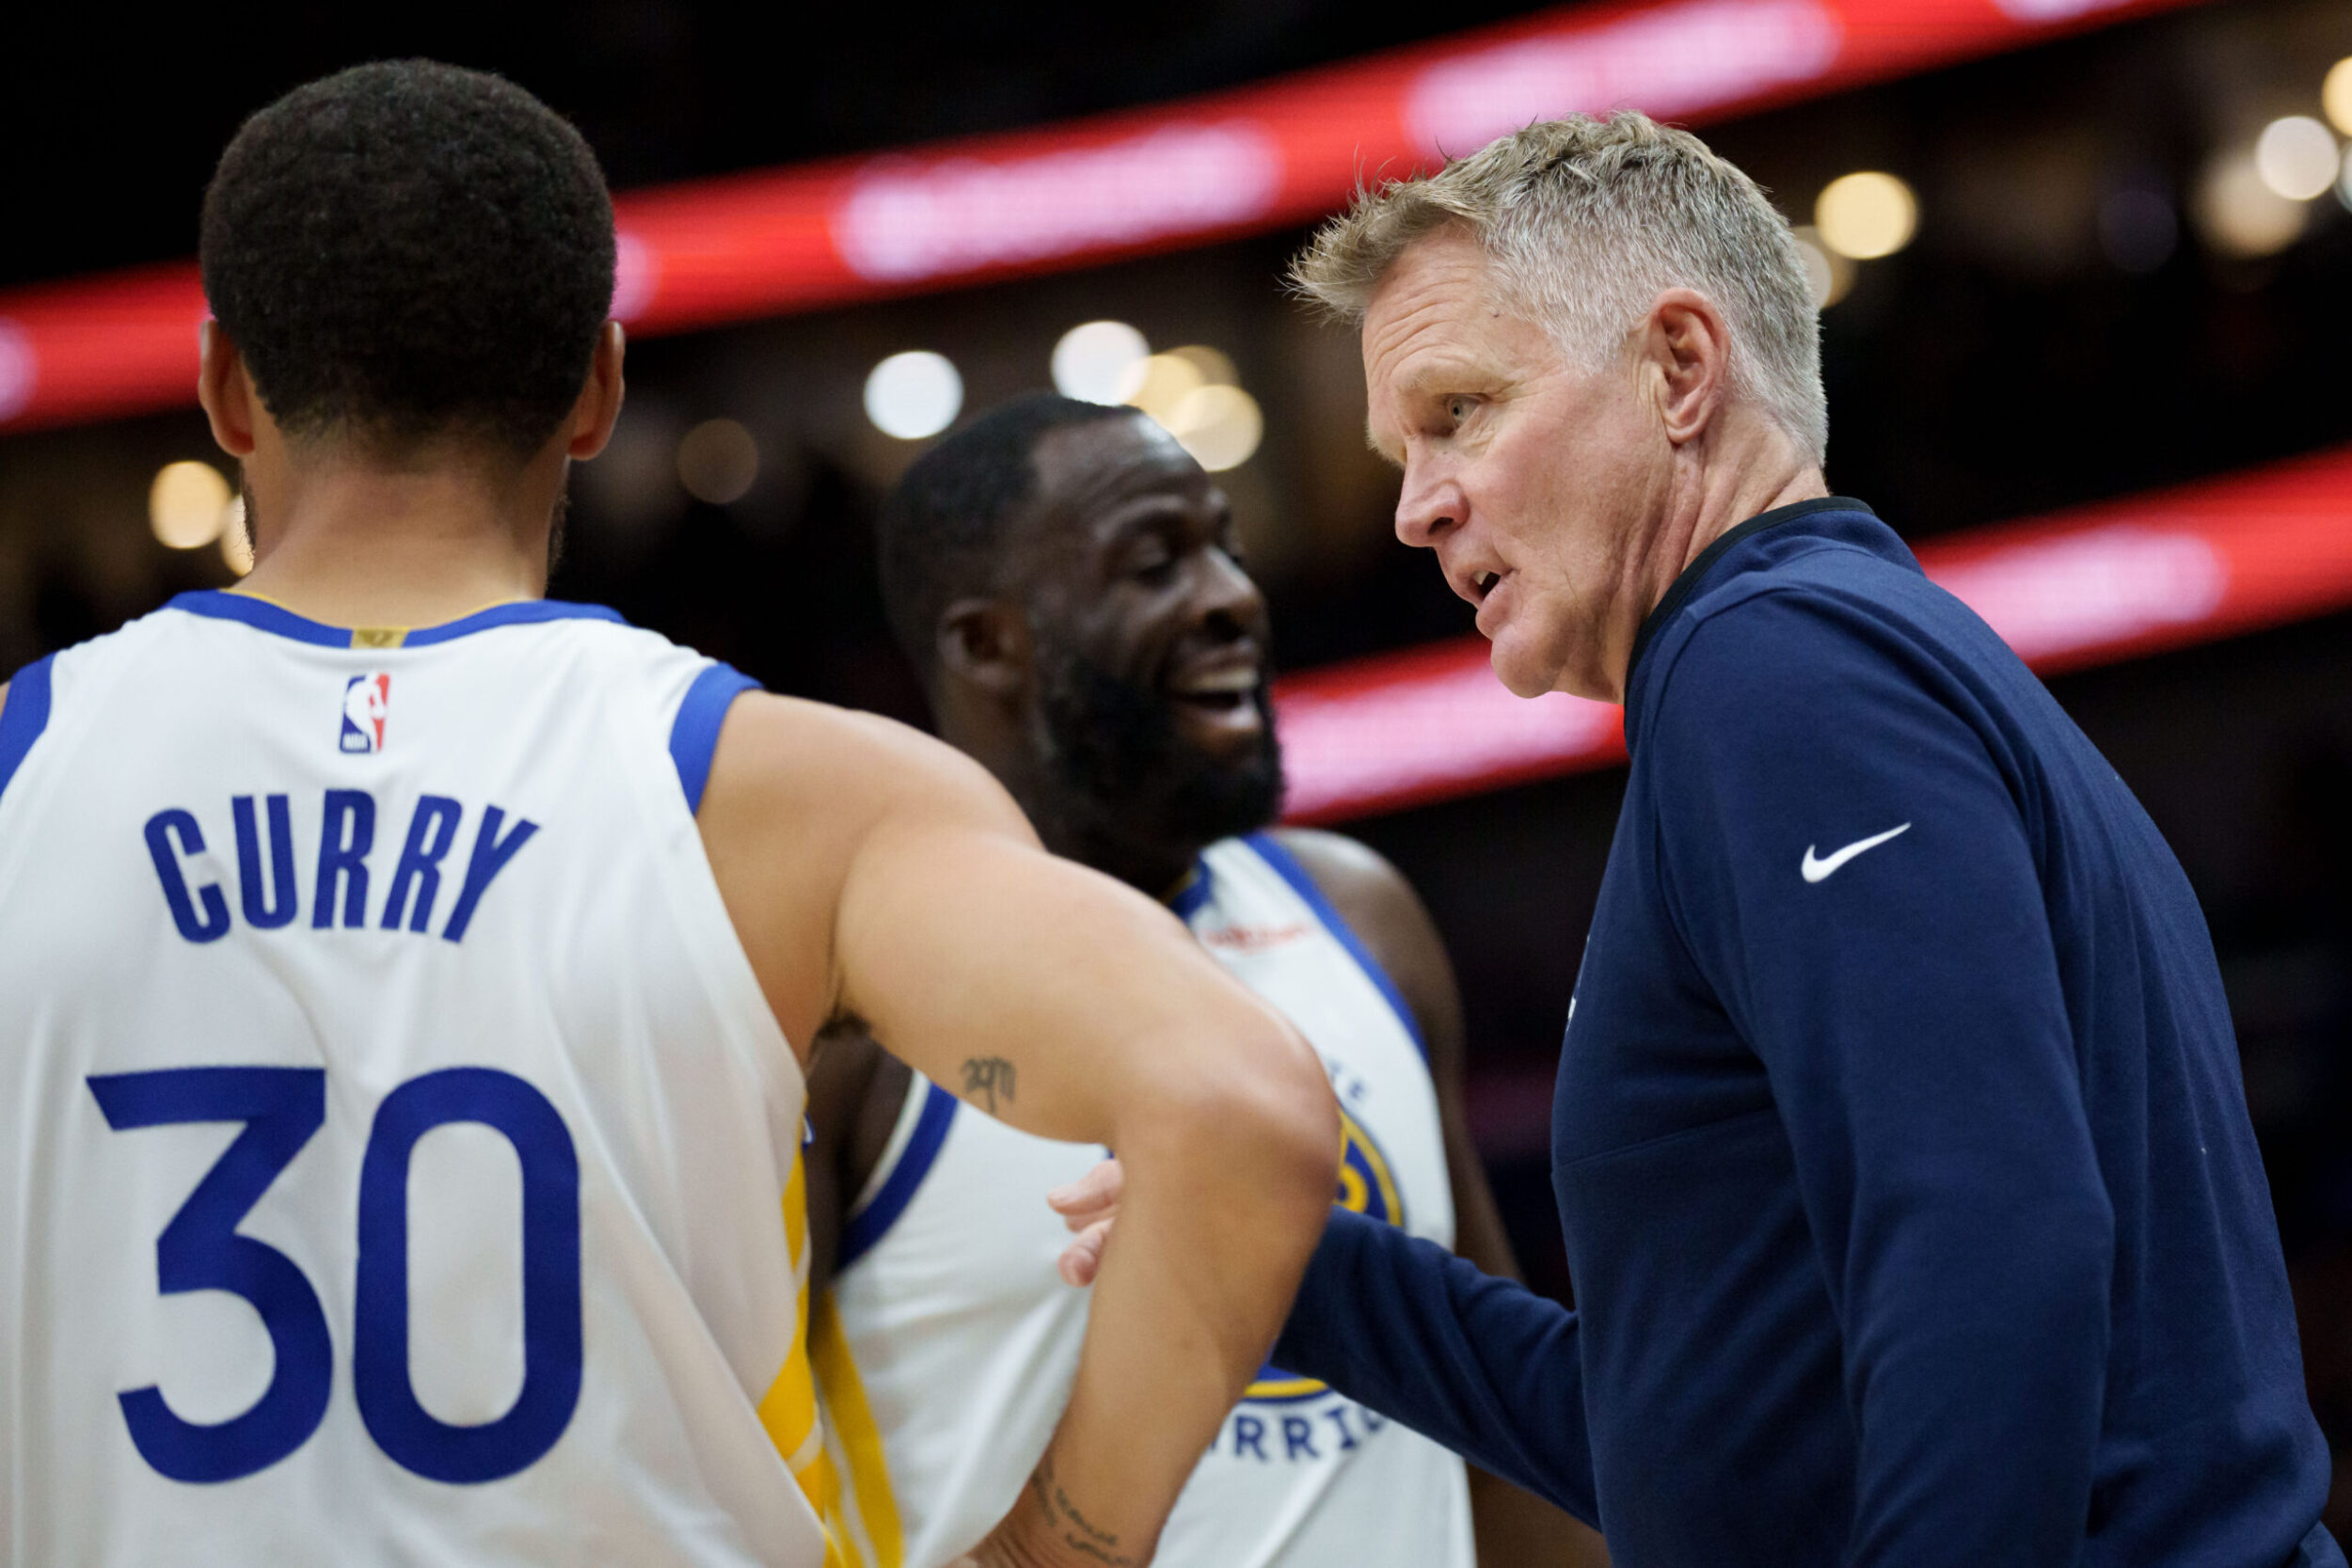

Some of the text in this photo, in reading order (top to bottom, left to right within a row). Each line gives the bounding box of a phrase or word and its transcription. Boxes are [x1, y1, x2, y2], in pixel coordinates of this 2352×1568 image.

[143, 787, 540, 944] CURRY
[85, 1064, 584, 1486] 30
[1210, 1405, 1386, 1462] RRI
